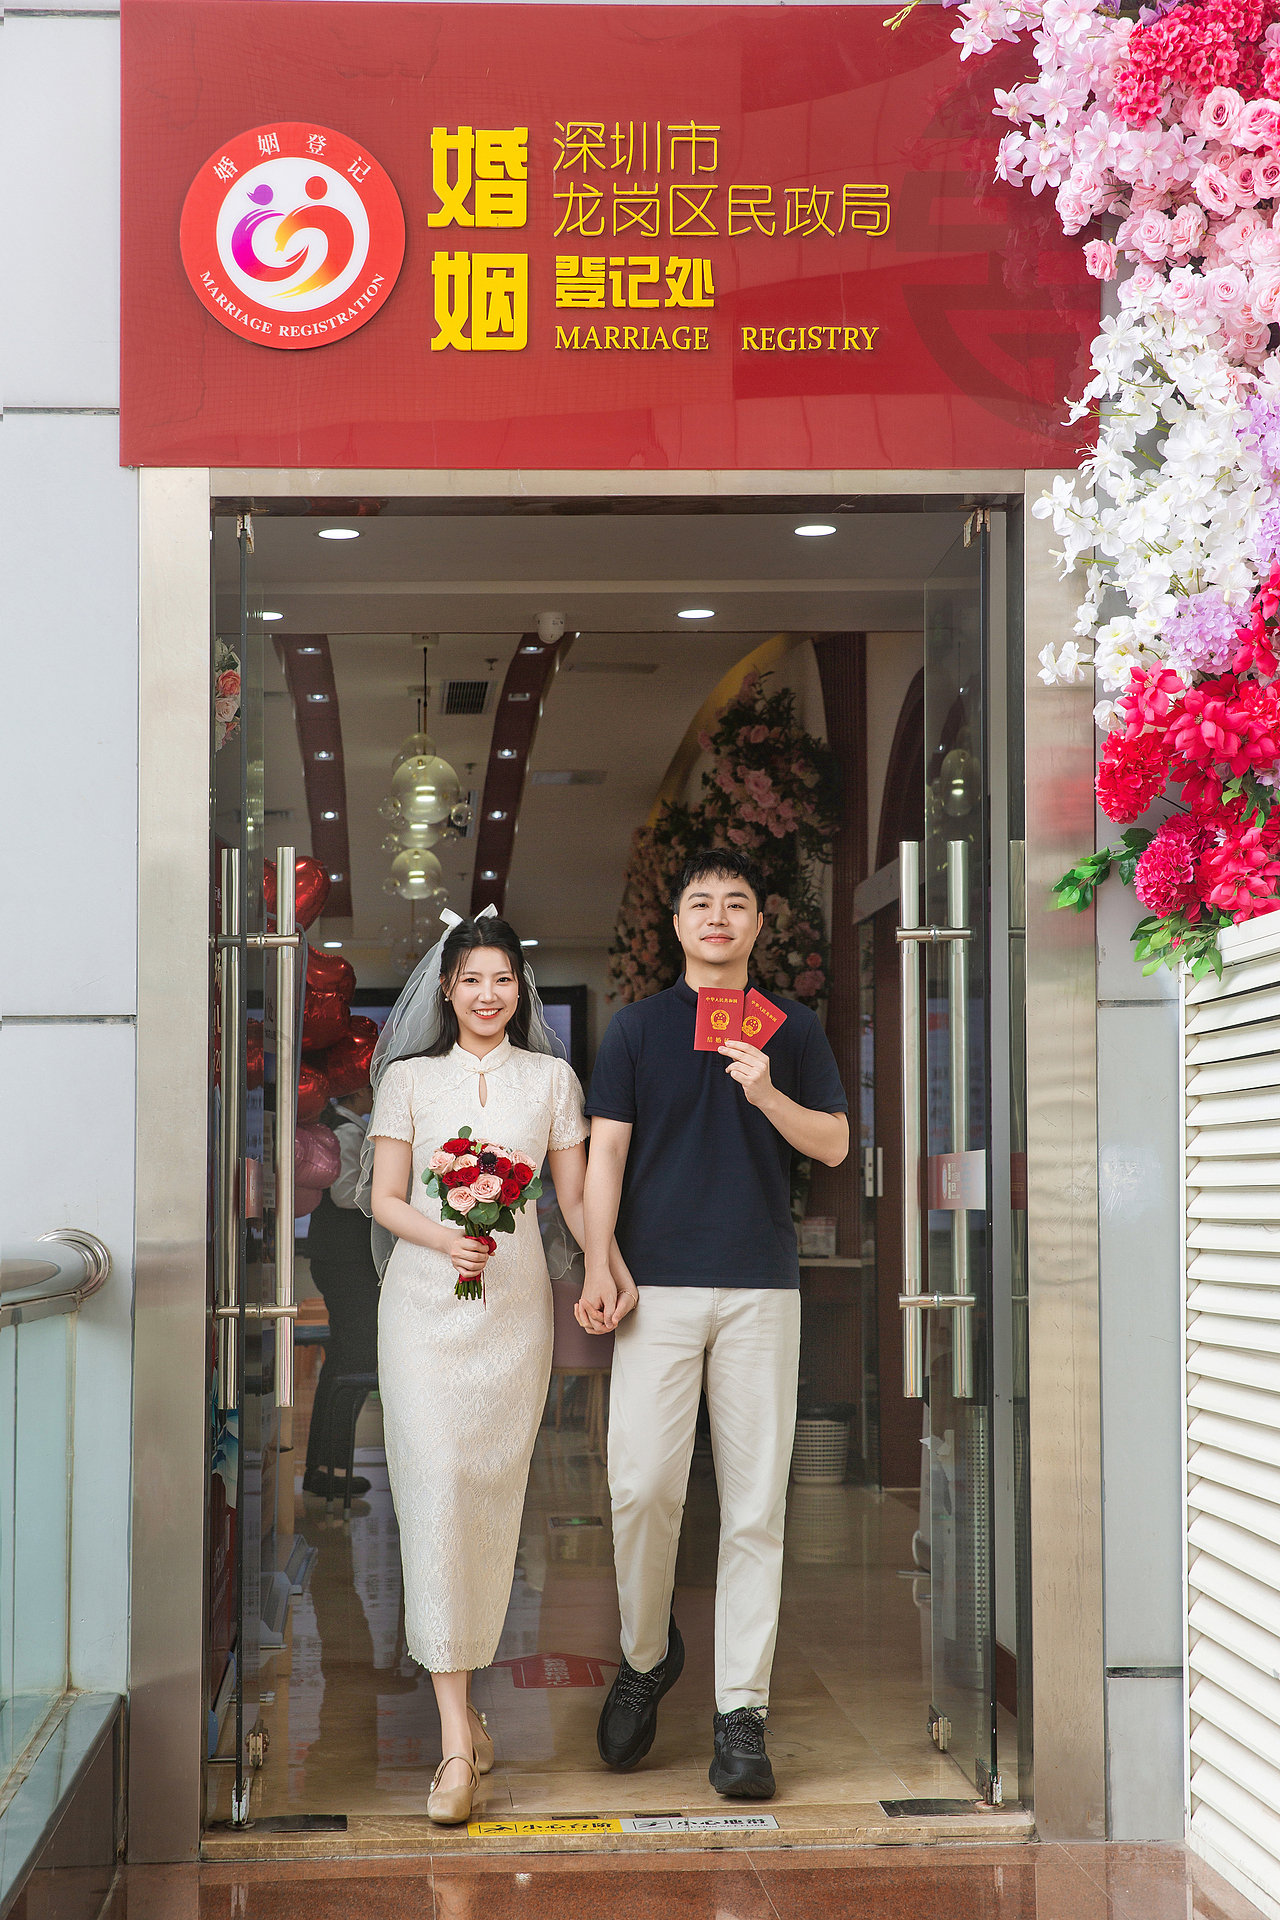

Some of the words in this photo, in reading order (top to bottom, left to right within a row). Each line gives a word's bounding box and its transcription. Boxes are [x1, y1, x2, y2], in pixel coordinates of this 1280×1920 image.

[213, 132, 372, 184] 婚姻登记
[553, 120, 720, 174] 深圳市
[553, 182, 890, 236] 龙岗区民政局
[427, 126, 528, 351] 婚姻
[200, 270, 272, 334] MARRIAGE
[278, 273, 385, 338] REGISTRATION
[555, 256, 715, 308] 登记处
[554, 326, 709, 350] MARRIAGE
[741, 327, 879, 350] REGISTRY
